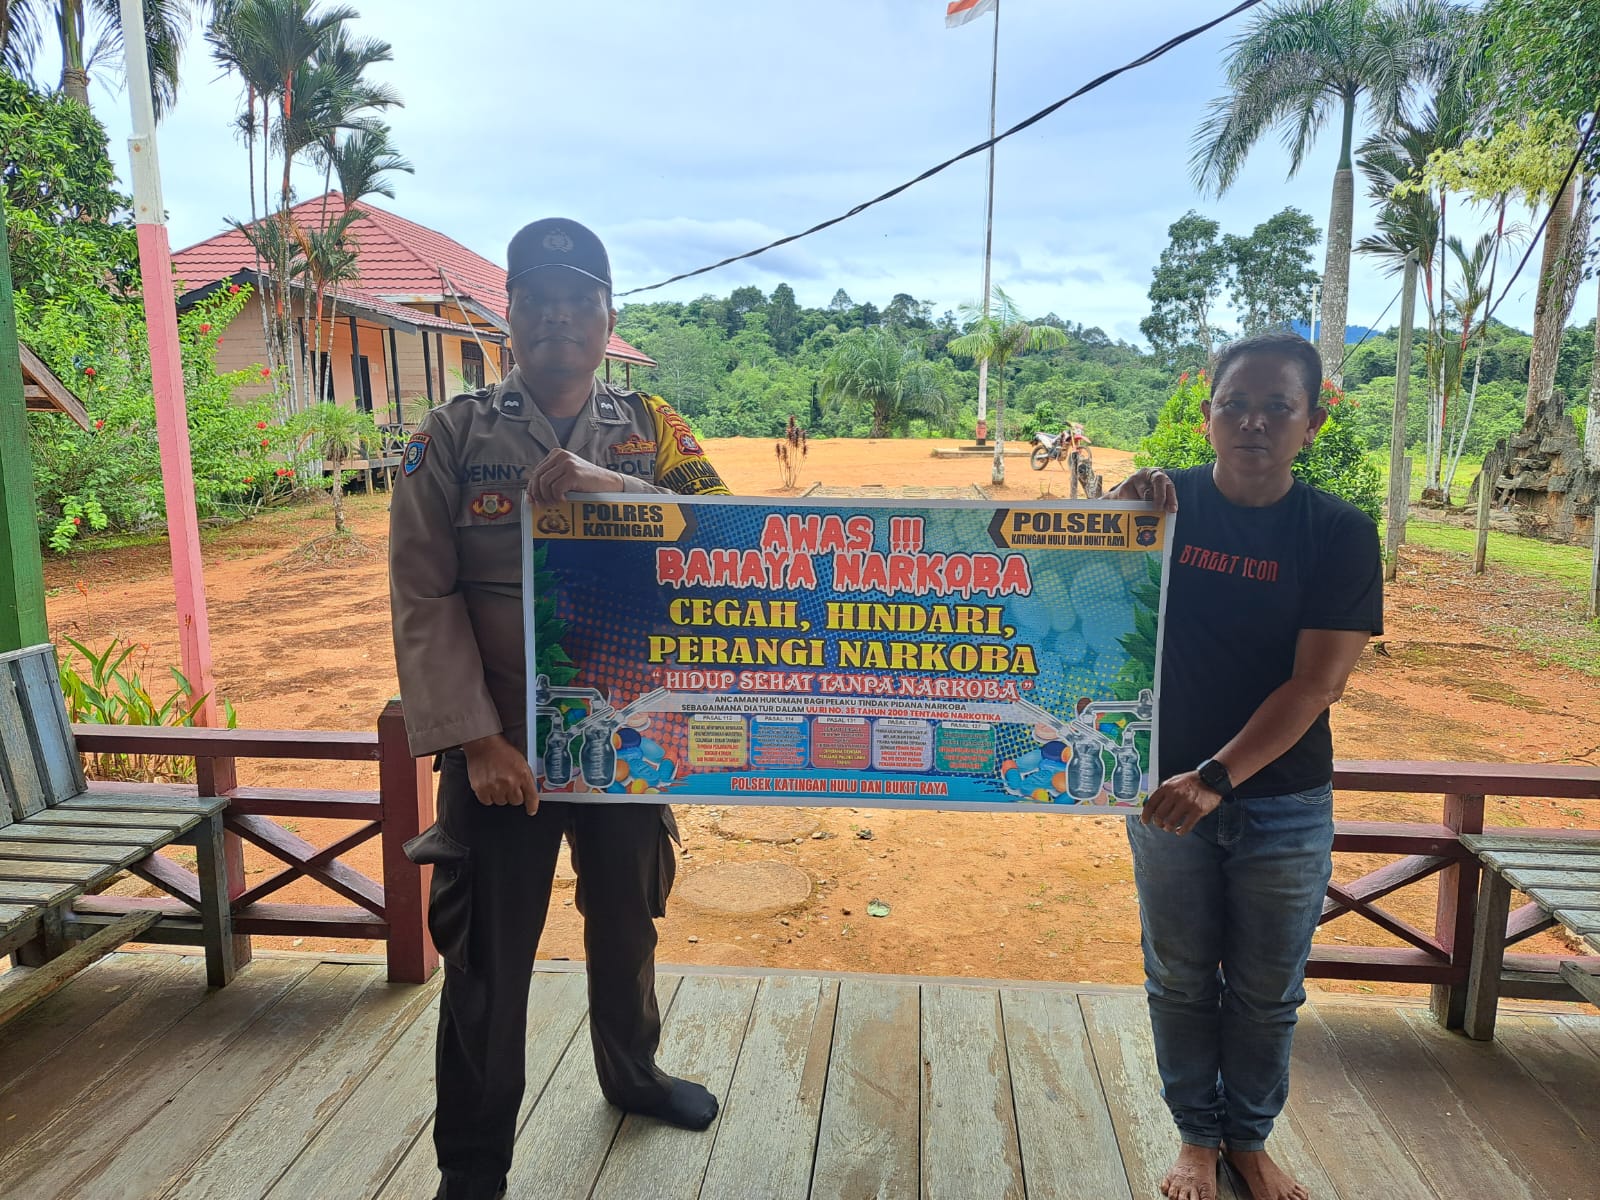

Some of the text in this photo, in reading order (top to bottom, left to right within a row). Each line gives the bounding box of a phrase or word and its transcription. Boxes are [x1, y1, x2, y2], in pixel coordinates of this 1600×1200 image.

[582, 503, 663, 522] POLRES
[1013, 512, 1122, 533] POLSEK
[583, 523, 664, 538] KATINGAN
[761, 514, 924, 553] AWAS !!!
[1011, 534, 1125, 547] KATINGAN HULU DAN BUKIT RAYA
[656, 547, 1032, 599] BAHAYA NARKOBA
[1178, 544, 1279, 582] STREET ICON
[669, 598, 1015, 638] CEGAH, HINDARI,
[648, 635, 1037, 674] PERANGI NARKOBA
[740, 671, 813, 691] SEHAT
[820, 674, 894, 694] TANPA
[682, 704, 1001, 721] SEBAGAIMANA DIATUR DALAM UU RI NO. 35 TAHUN 2009 TENTANG NARKOTIKA
[715, 695, 966, 711] ANCAMAN HUKUMAN BAGI PELAKU TINDAK PIDANA NARKOBA
[731, 777, 948, 796] POLSEK KATINGAN HULU DAN BUKIT RAYA
